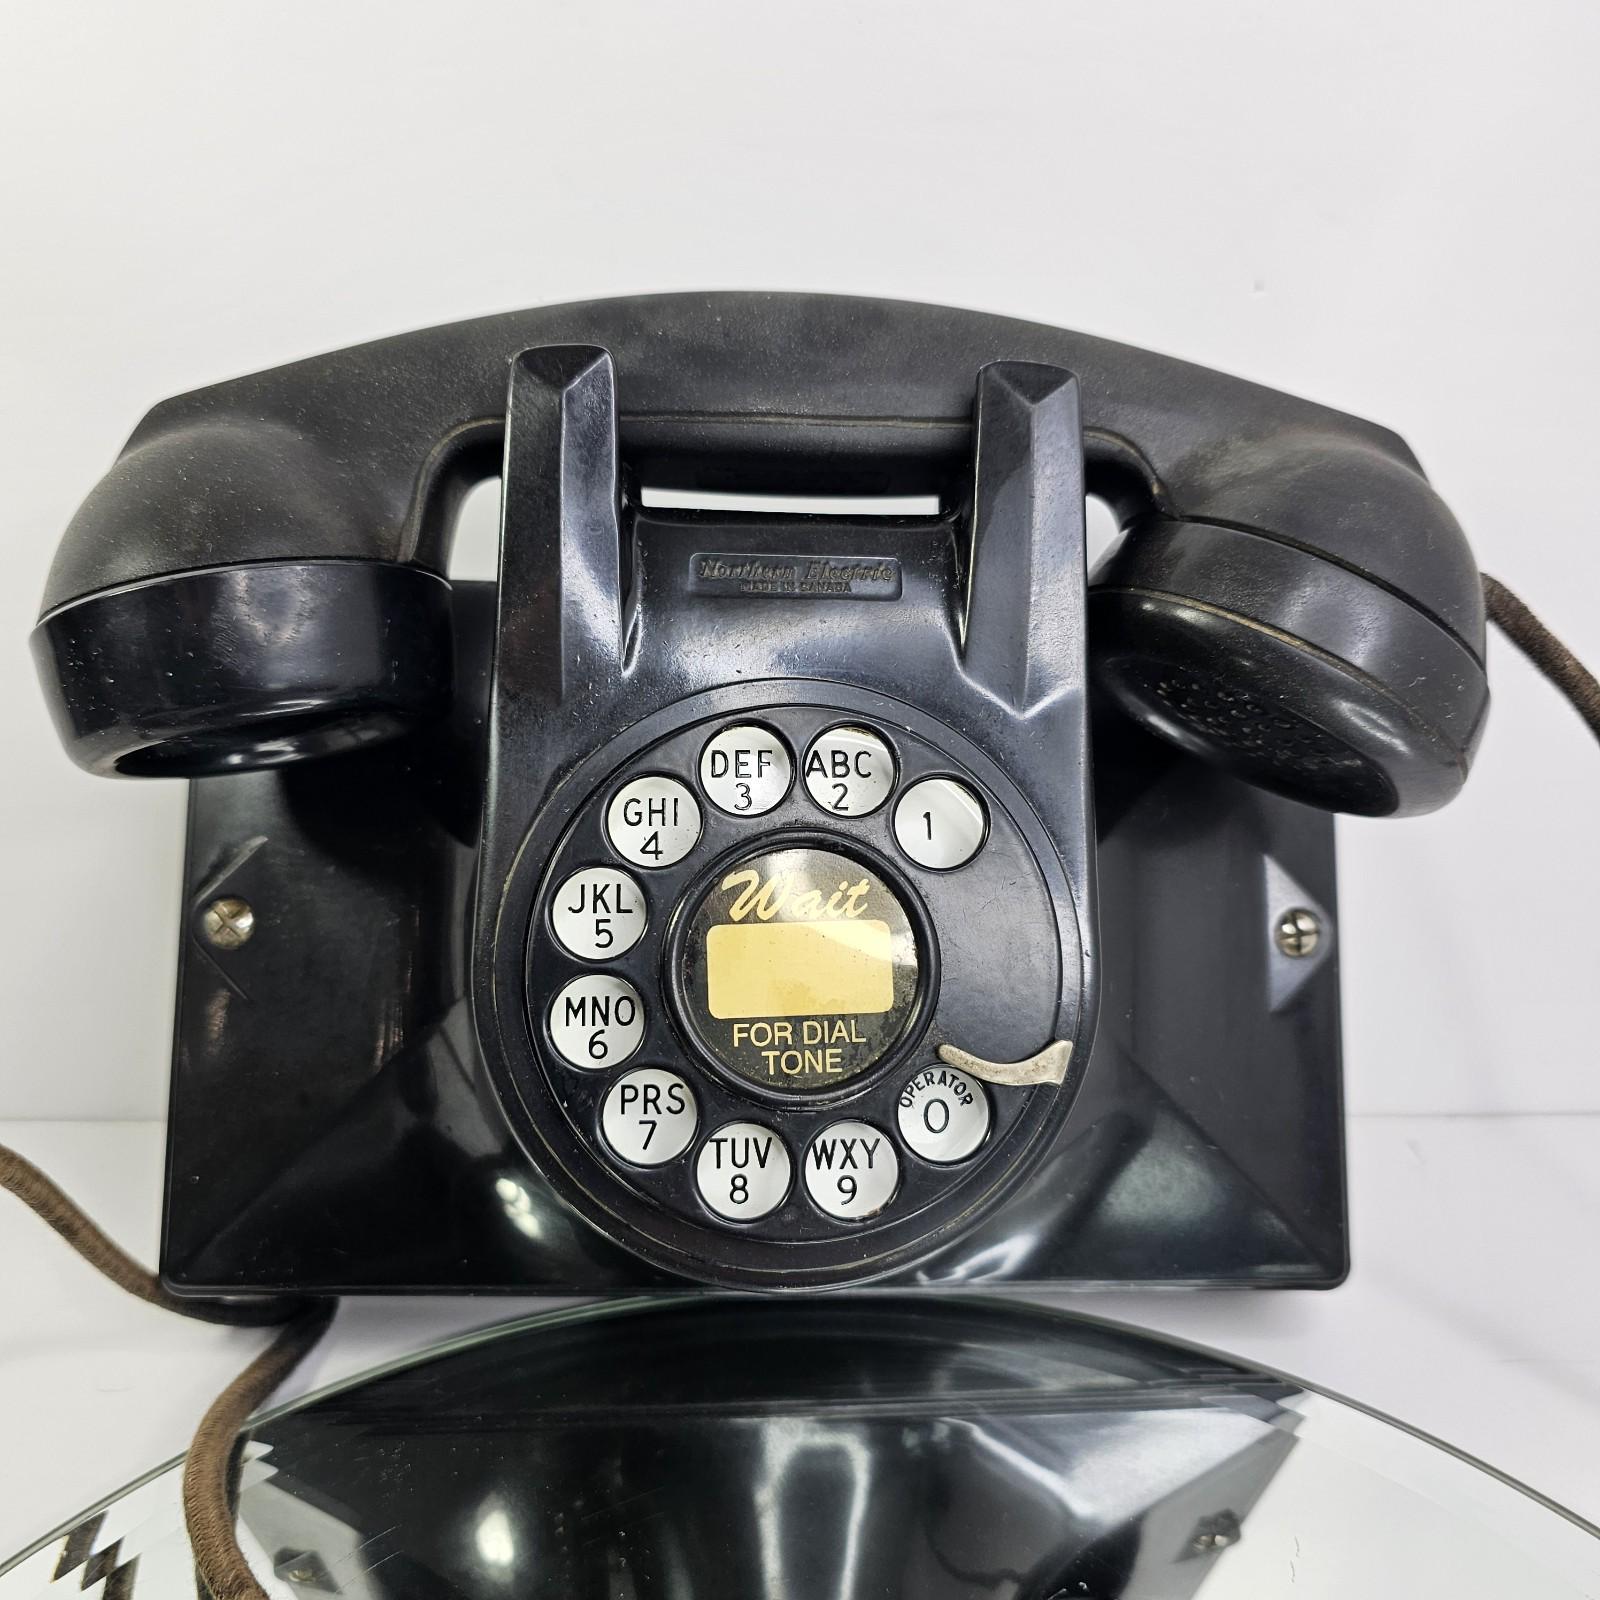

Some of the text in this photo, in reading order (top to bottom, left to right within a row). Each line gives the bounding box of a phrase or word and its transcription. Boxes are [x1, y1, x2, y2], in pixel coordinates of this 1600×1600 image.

[806, 561, 896, 582] Electric
[741, 581, 851, 593] MADE IN CANADA
[711, 749, 773, 778] DEF
[806, 750, 872, 779] ABC
[622, 797, 679, 827] GHI
[733, 784, 753, 811] 3
[832, 784, 849, 811] 2
[922, 811, 932, 840] 1
[639, 831, 664, 861] 4
[567, 883, 633, 915] JKL
[721, 869, 870, 922] Wait
[594, 919, 614, 949] 5
[564, 995, 636, 1027] MNO
[588, 1030, 608, 1060] 6
[733, 1019, 867, 1047] FOR DIAL
[761, 1048, 843, 1075] TONE
[620, 1083, 686, 1115] PRS
[899, 1071, 974, 1108] OPERATOR
[638, 1119, 657, 1151] 7
[709, 1136, 773, 1169] TUV
[811, 1138, 882, 1170] WXY
[729, 1174, 749, 1204] 8
[836, 1175, 857, 1206] 9
